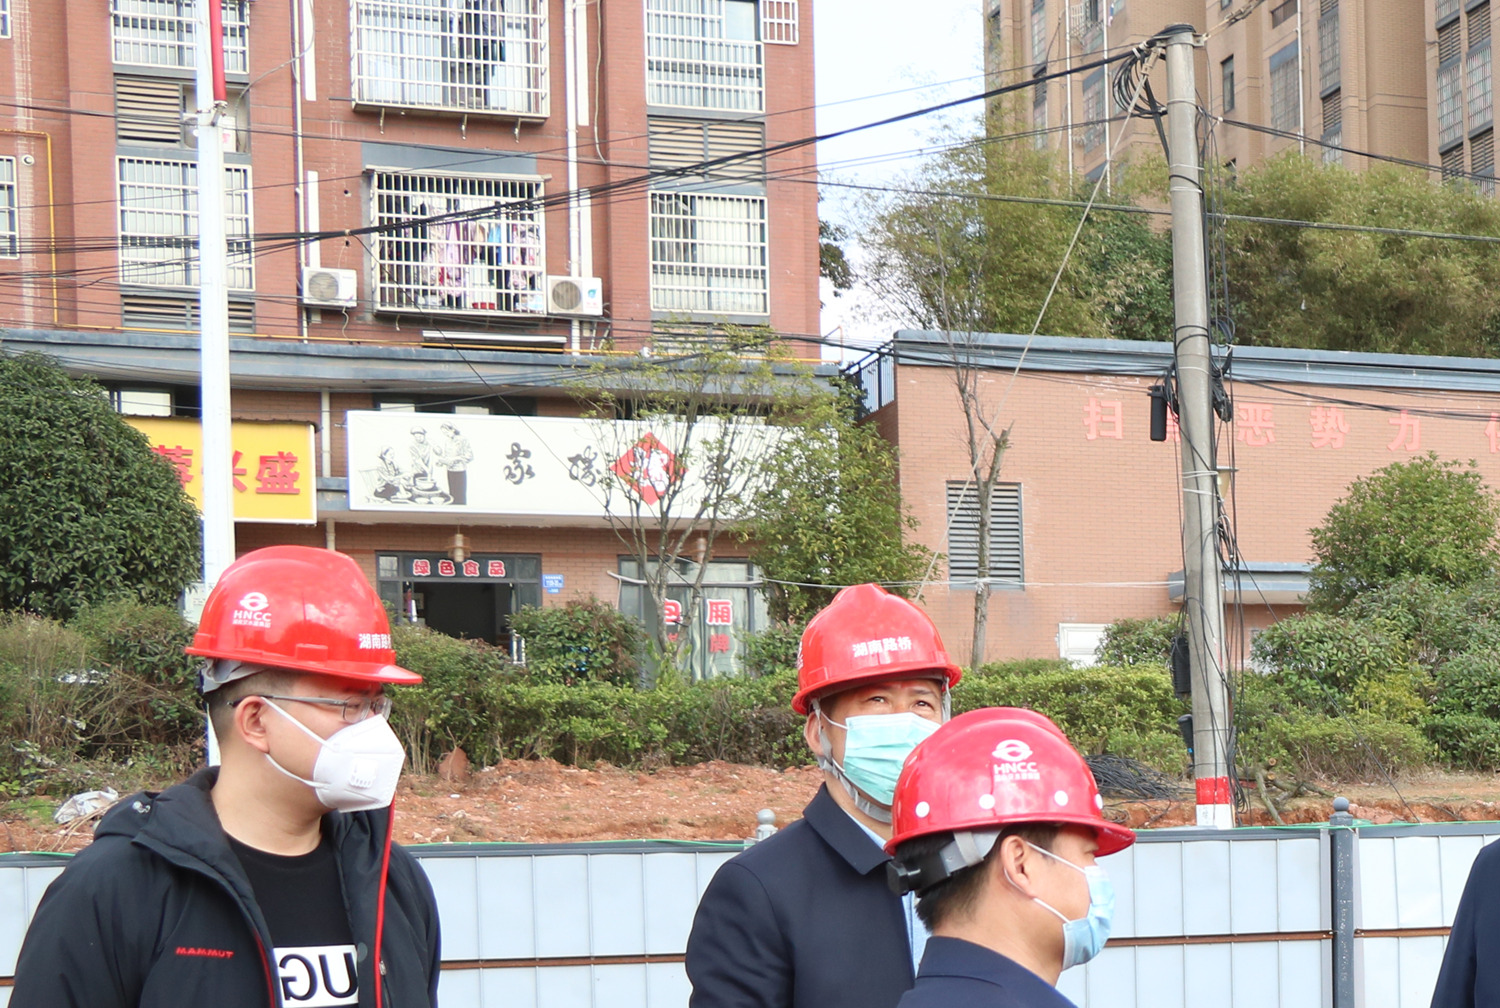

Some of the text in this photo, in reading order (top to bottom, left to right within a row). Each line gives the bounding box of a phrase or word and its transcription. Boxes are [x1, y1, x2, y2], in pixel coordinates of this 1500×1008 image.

[1083, 397, 1421, 452] 扫恶势力
[413, 559, 506, 578] 绿色食品
[233, 610, 272, 622] HNCC
[852, 636, 912, 658] 湖南路桥
[993, 761, 1038, 775] HNCC
[175, 946, 234, 959] MAMMUT
